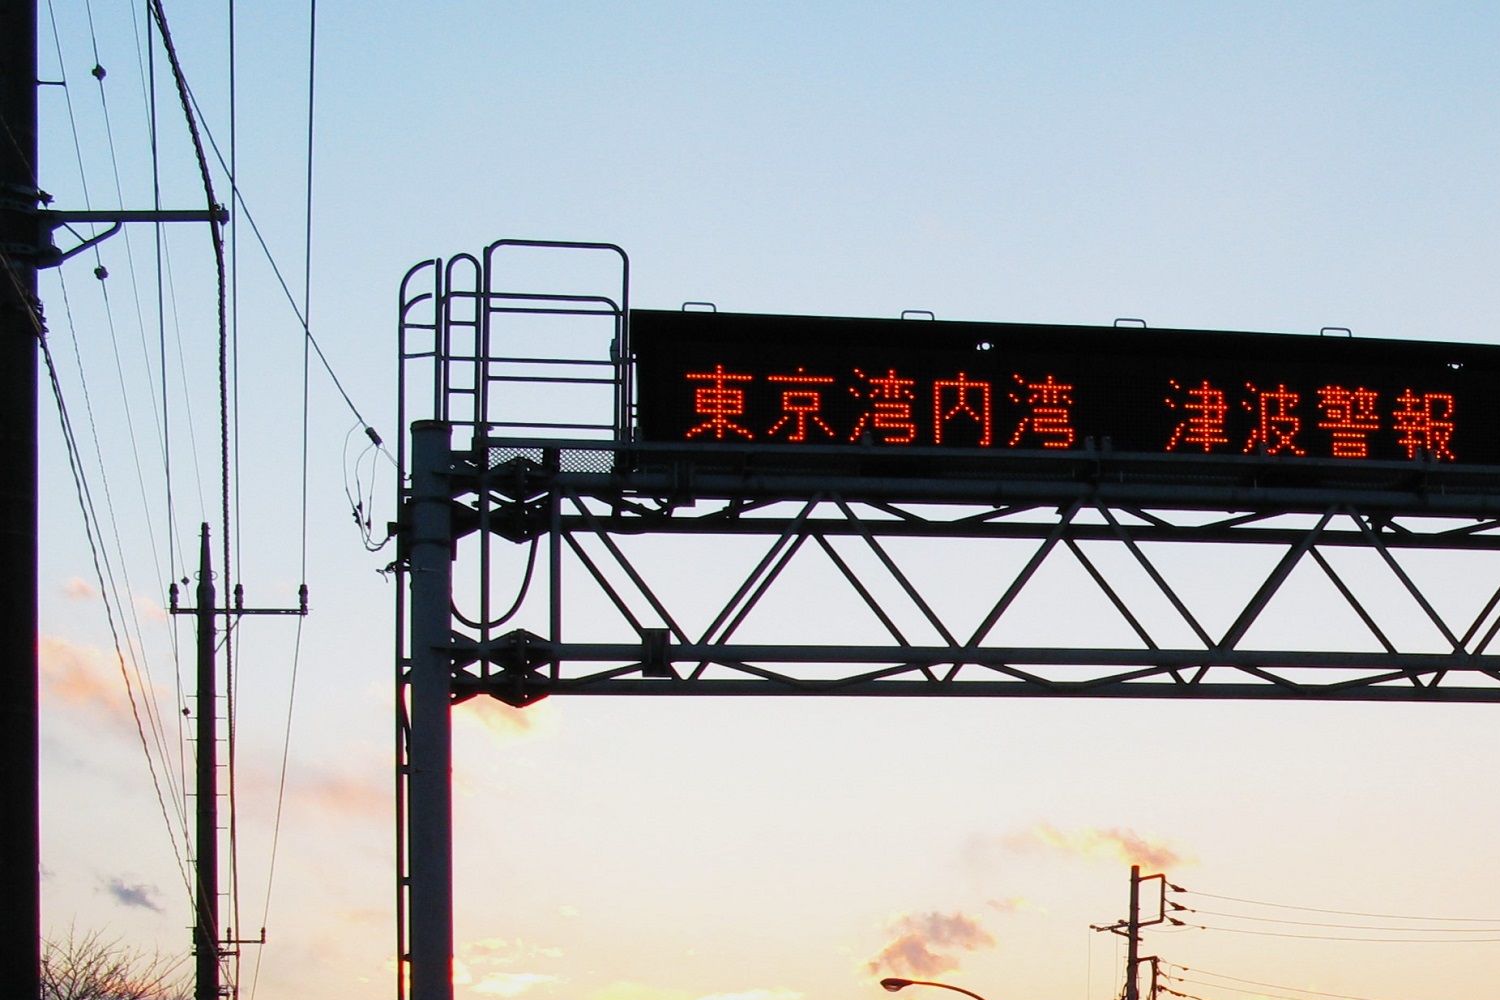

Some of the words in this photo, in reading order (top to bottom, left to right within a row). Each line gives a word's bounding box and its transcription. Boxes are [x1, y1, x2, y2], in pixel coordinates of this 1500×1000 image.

[687, 365, 1072, 447] 東京湾内湾
[1166, 380, 1454, 459] 津波警報
